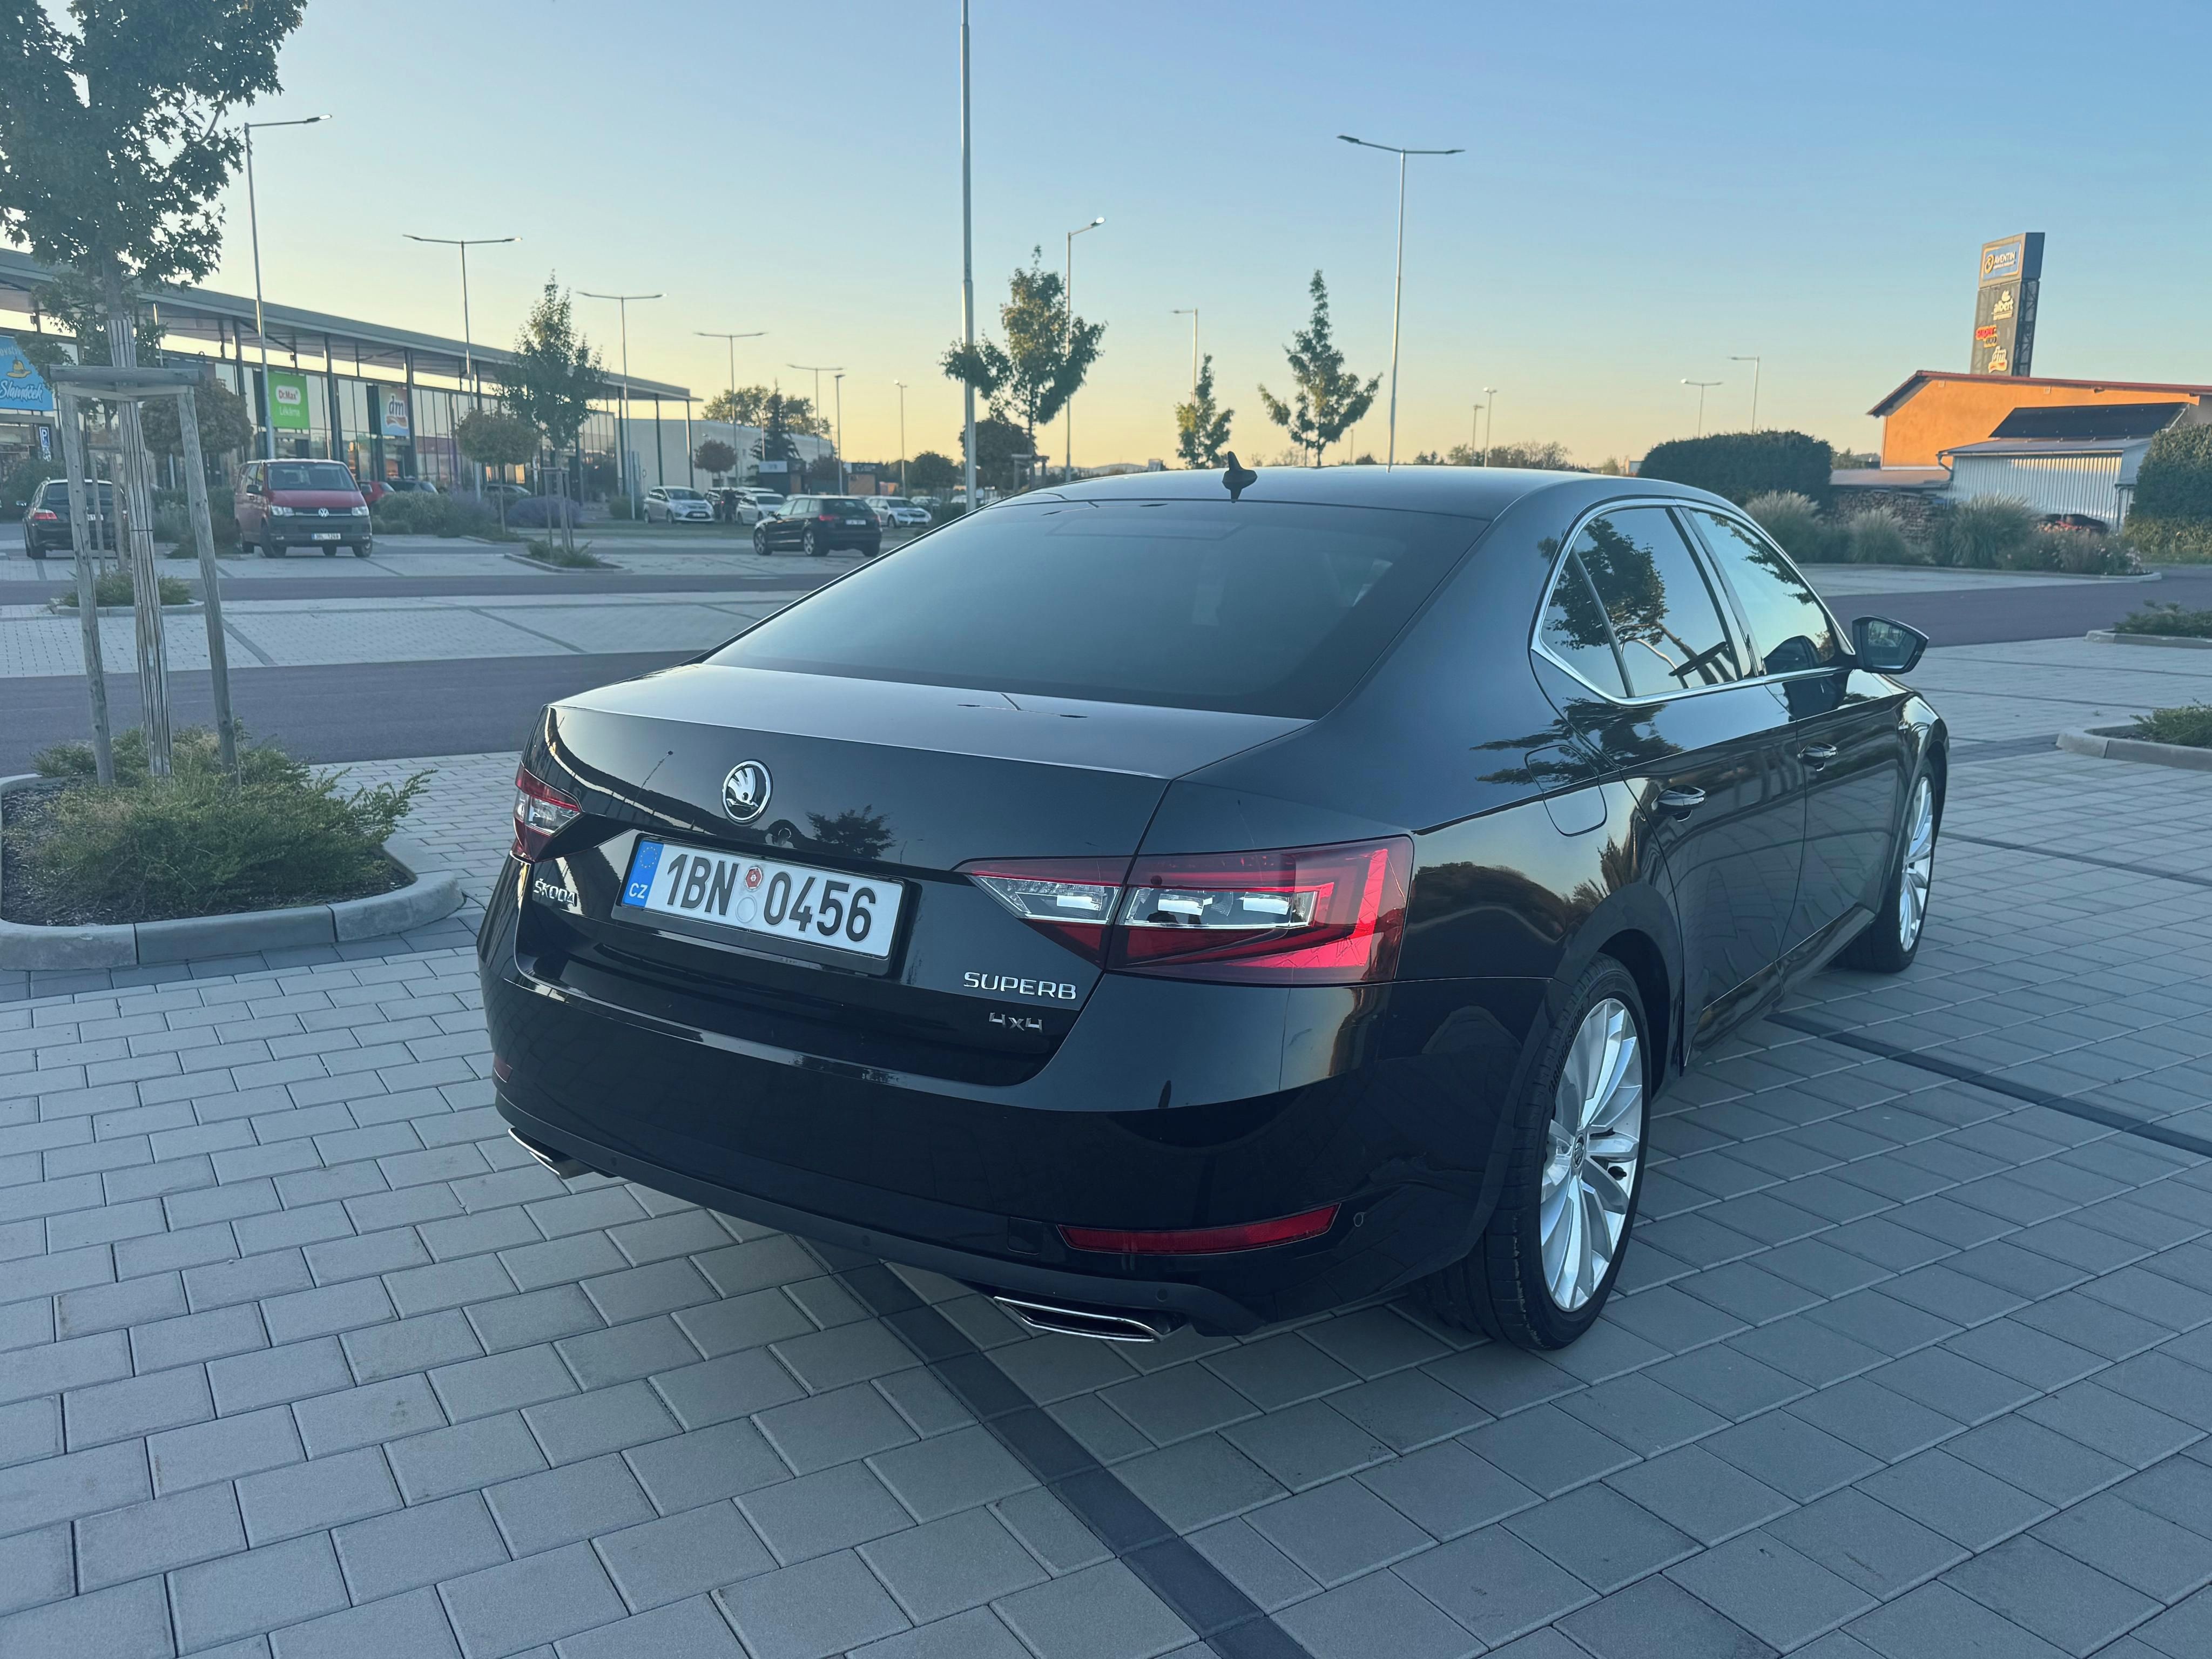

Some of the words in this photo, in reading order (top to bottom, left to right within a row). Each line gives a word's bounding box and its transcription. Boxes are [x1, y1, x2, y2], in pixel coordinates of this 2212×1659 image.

[1994, 298, 2014, 312] albert
[1993, 348, 2005, 362] dm
[389, 396, 405, 415] dm
[533, 878, 577, 907] ŠKODA
[629, 881, 649, 900] CZ
[666, 853, 739, 916] 1BN
[763, 872, 876, 942] 0456
[963, 972, 1077, 1000] SUPERB
